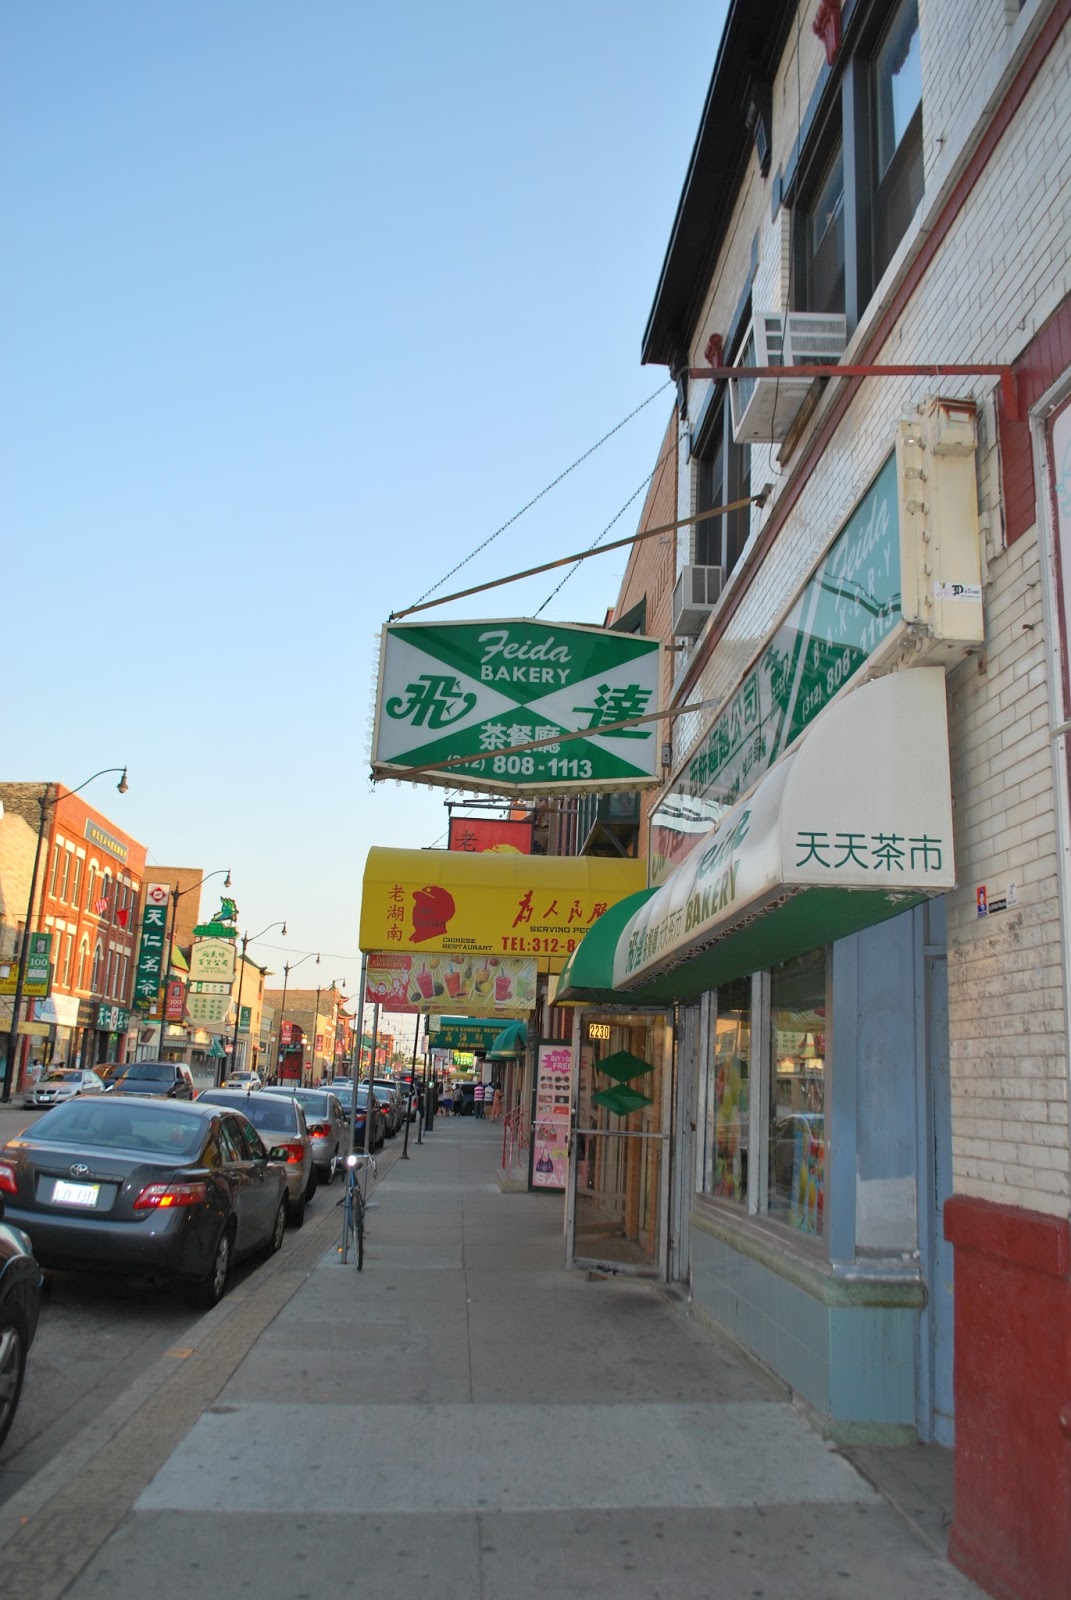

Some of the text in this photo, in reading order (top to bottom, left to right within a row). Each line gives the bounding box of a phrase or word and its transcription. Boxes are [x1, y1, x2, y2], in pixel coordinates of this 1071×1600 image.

[478, 630, 572, 664] Feida
[481, 665, 572, 684] BAKERY
[493, 755, 593, 779] 808-1113
[795, 831, 942, 872] 天天茶市
[685, 858, 741, 934] BAKERY
[386, 884, 406, 942] 老湖南
[137, 909, 164, 996] 天仁茗茶
[501, 936, 580, 953] TEL:312-8
[30, 959, 48, 967] 100
[589, 1024, 610, 1039] 2230
[552, 1062, 572, 1070] FREE
[535, 1172, 566, 1185] SAL
